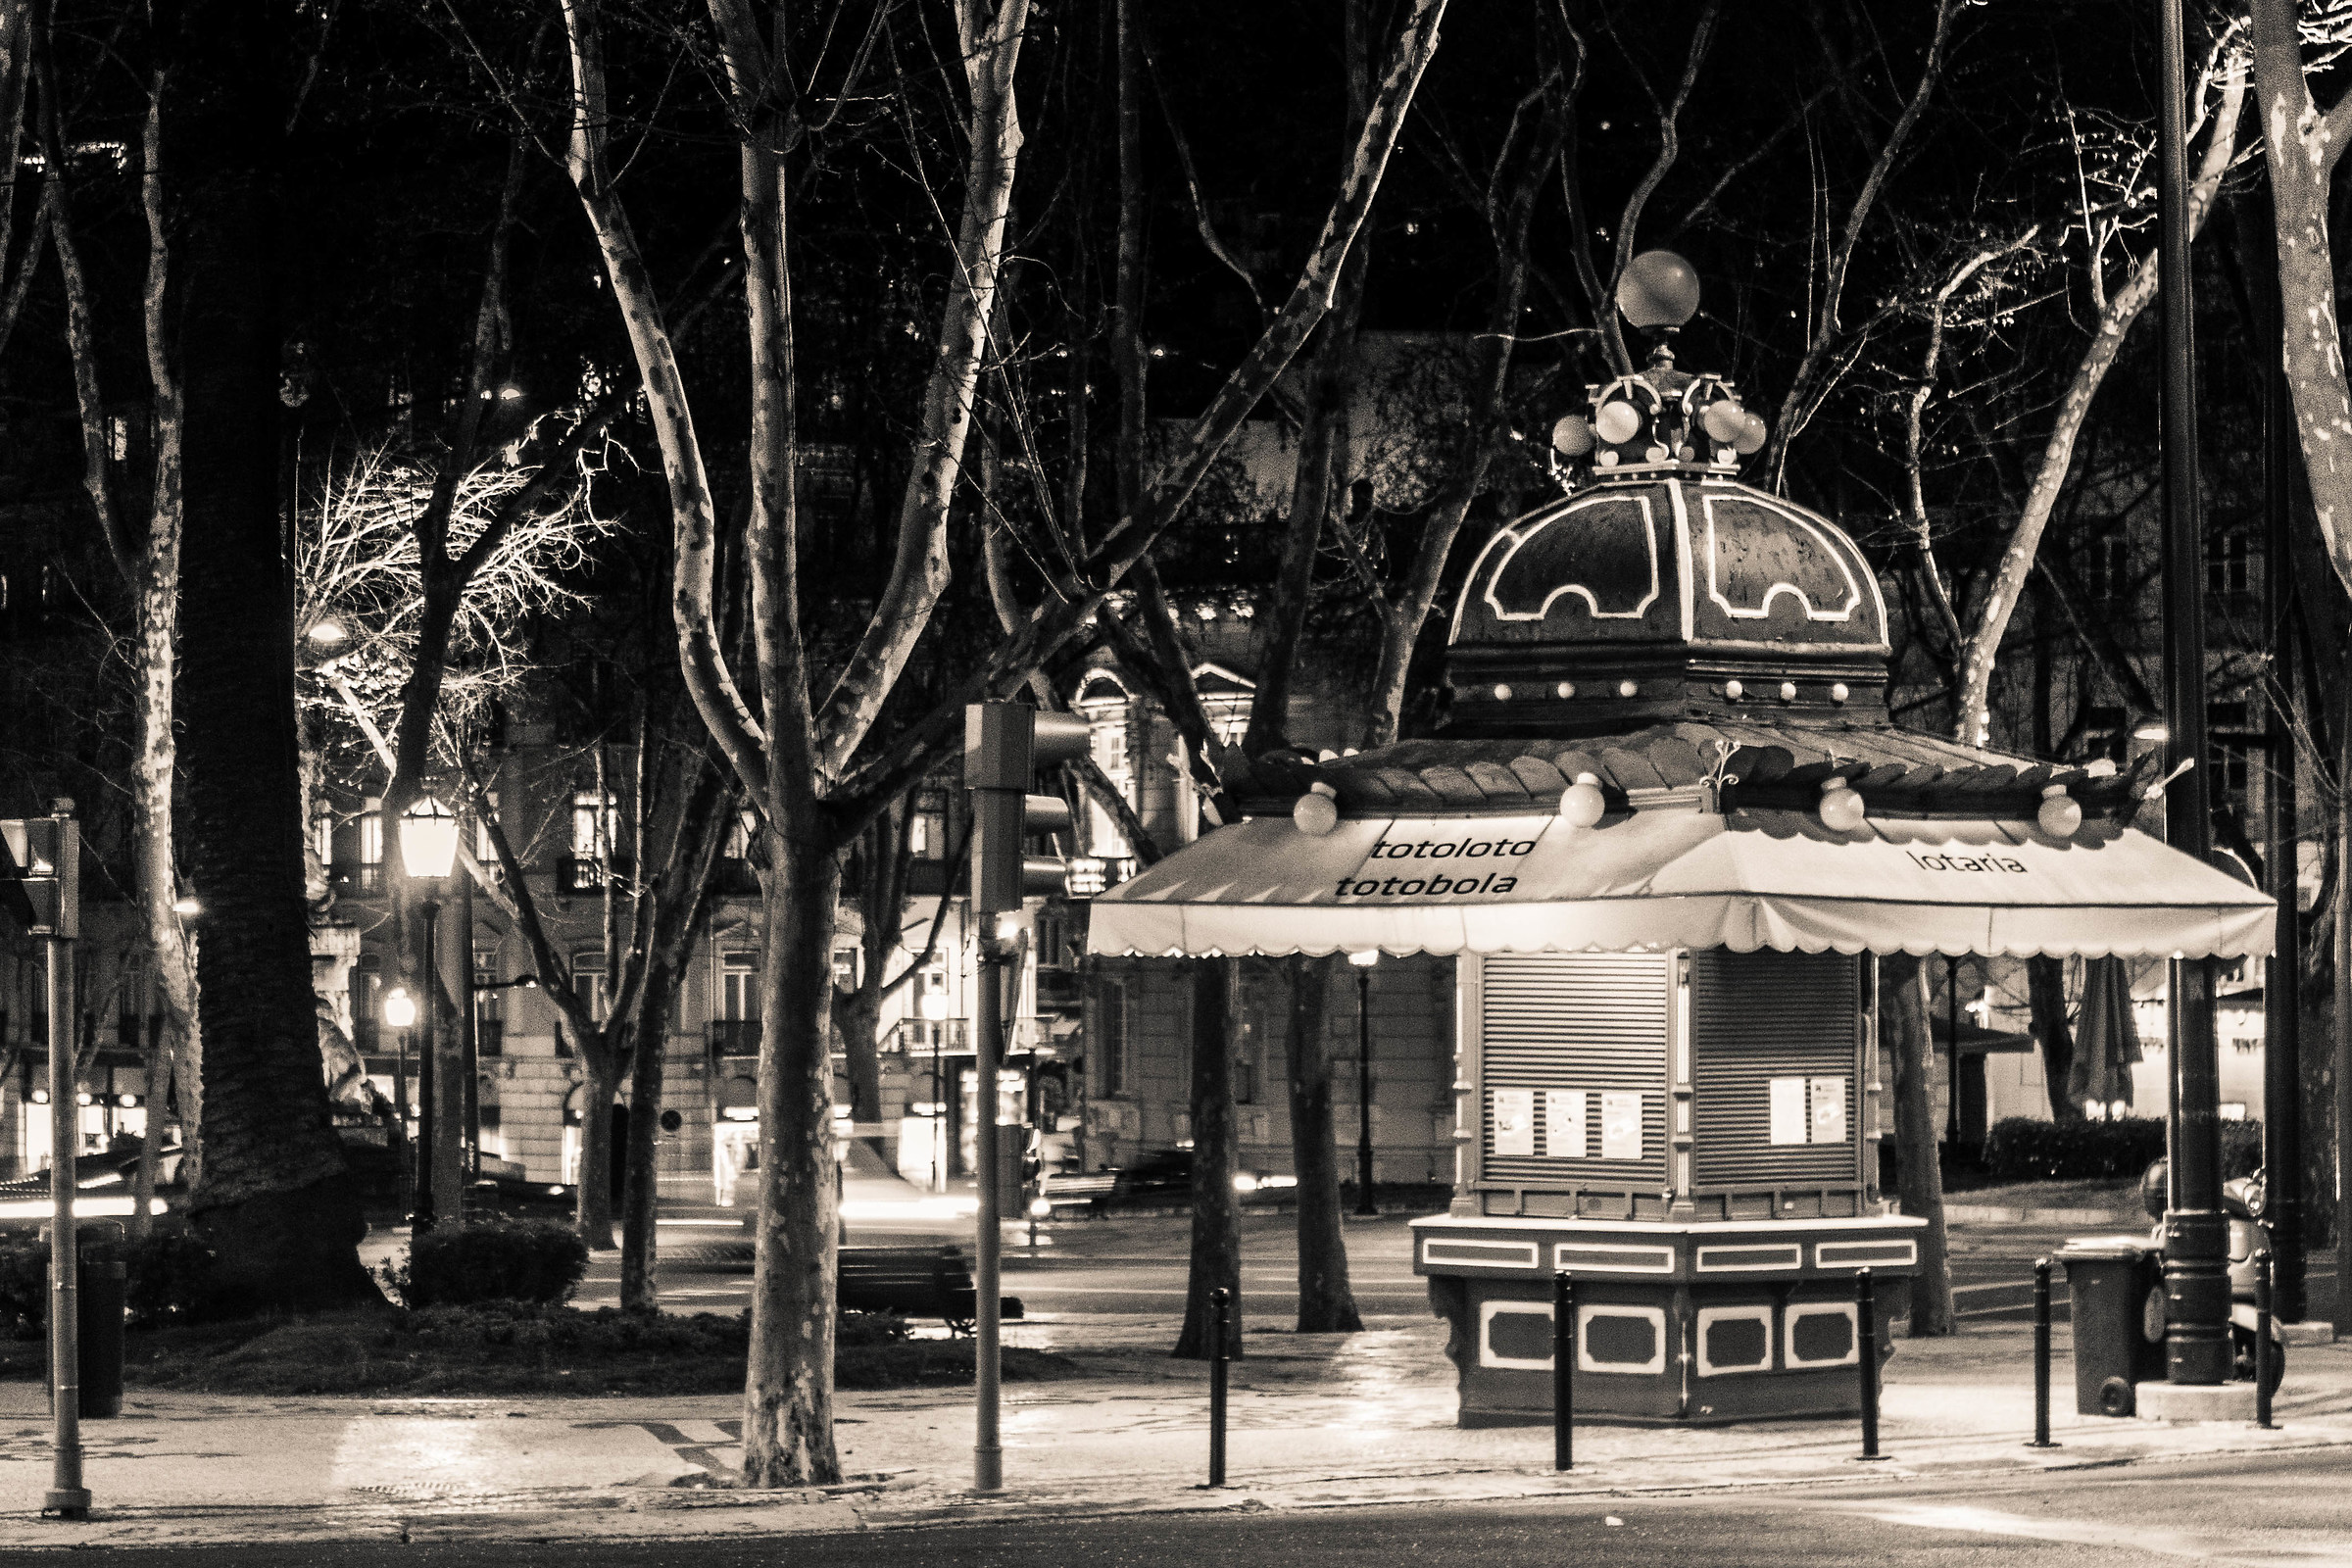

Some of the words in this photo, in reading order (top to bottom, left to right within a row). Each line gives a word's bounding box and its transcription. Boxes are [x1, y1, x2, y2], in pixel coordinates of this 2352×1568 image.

[1371, 838, 1536, 858] totoloto
[1906, 851, 2028, 872] lotaria
[1335, 873, 1518, 896] totobola
